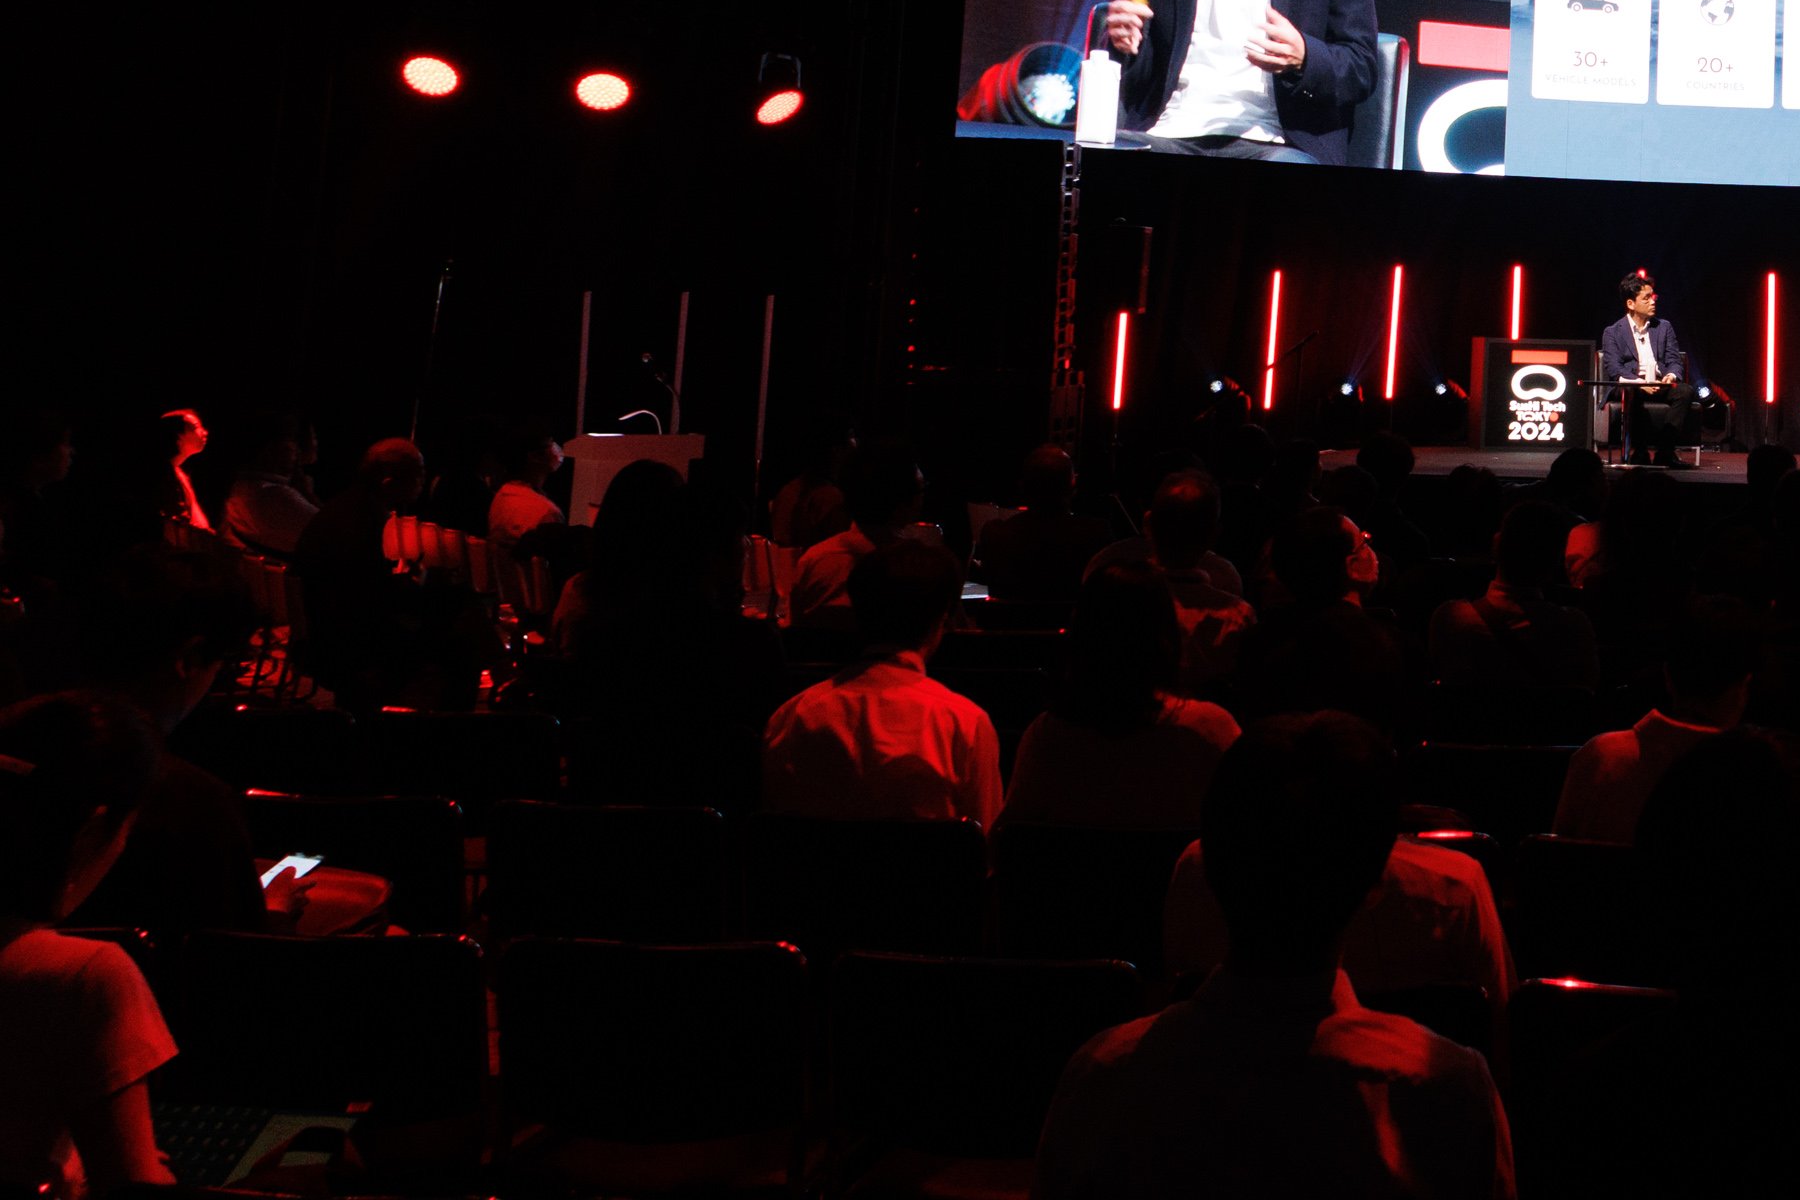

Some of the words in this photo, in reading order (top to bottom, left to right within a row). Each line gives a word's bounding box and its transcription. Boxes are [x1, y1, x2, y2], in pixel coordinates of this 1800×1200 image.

[1572, 50, 1609, 68] 30+
[1697, 57, 1734, 74] 20+
[1544, 73, 1590, 86] VEHICLE
[1592, 76, 1637, 88] MODELS
[1685, 79, 1745, 92] COUNTRIES
[1508, 421, 1565, 441] 2024
